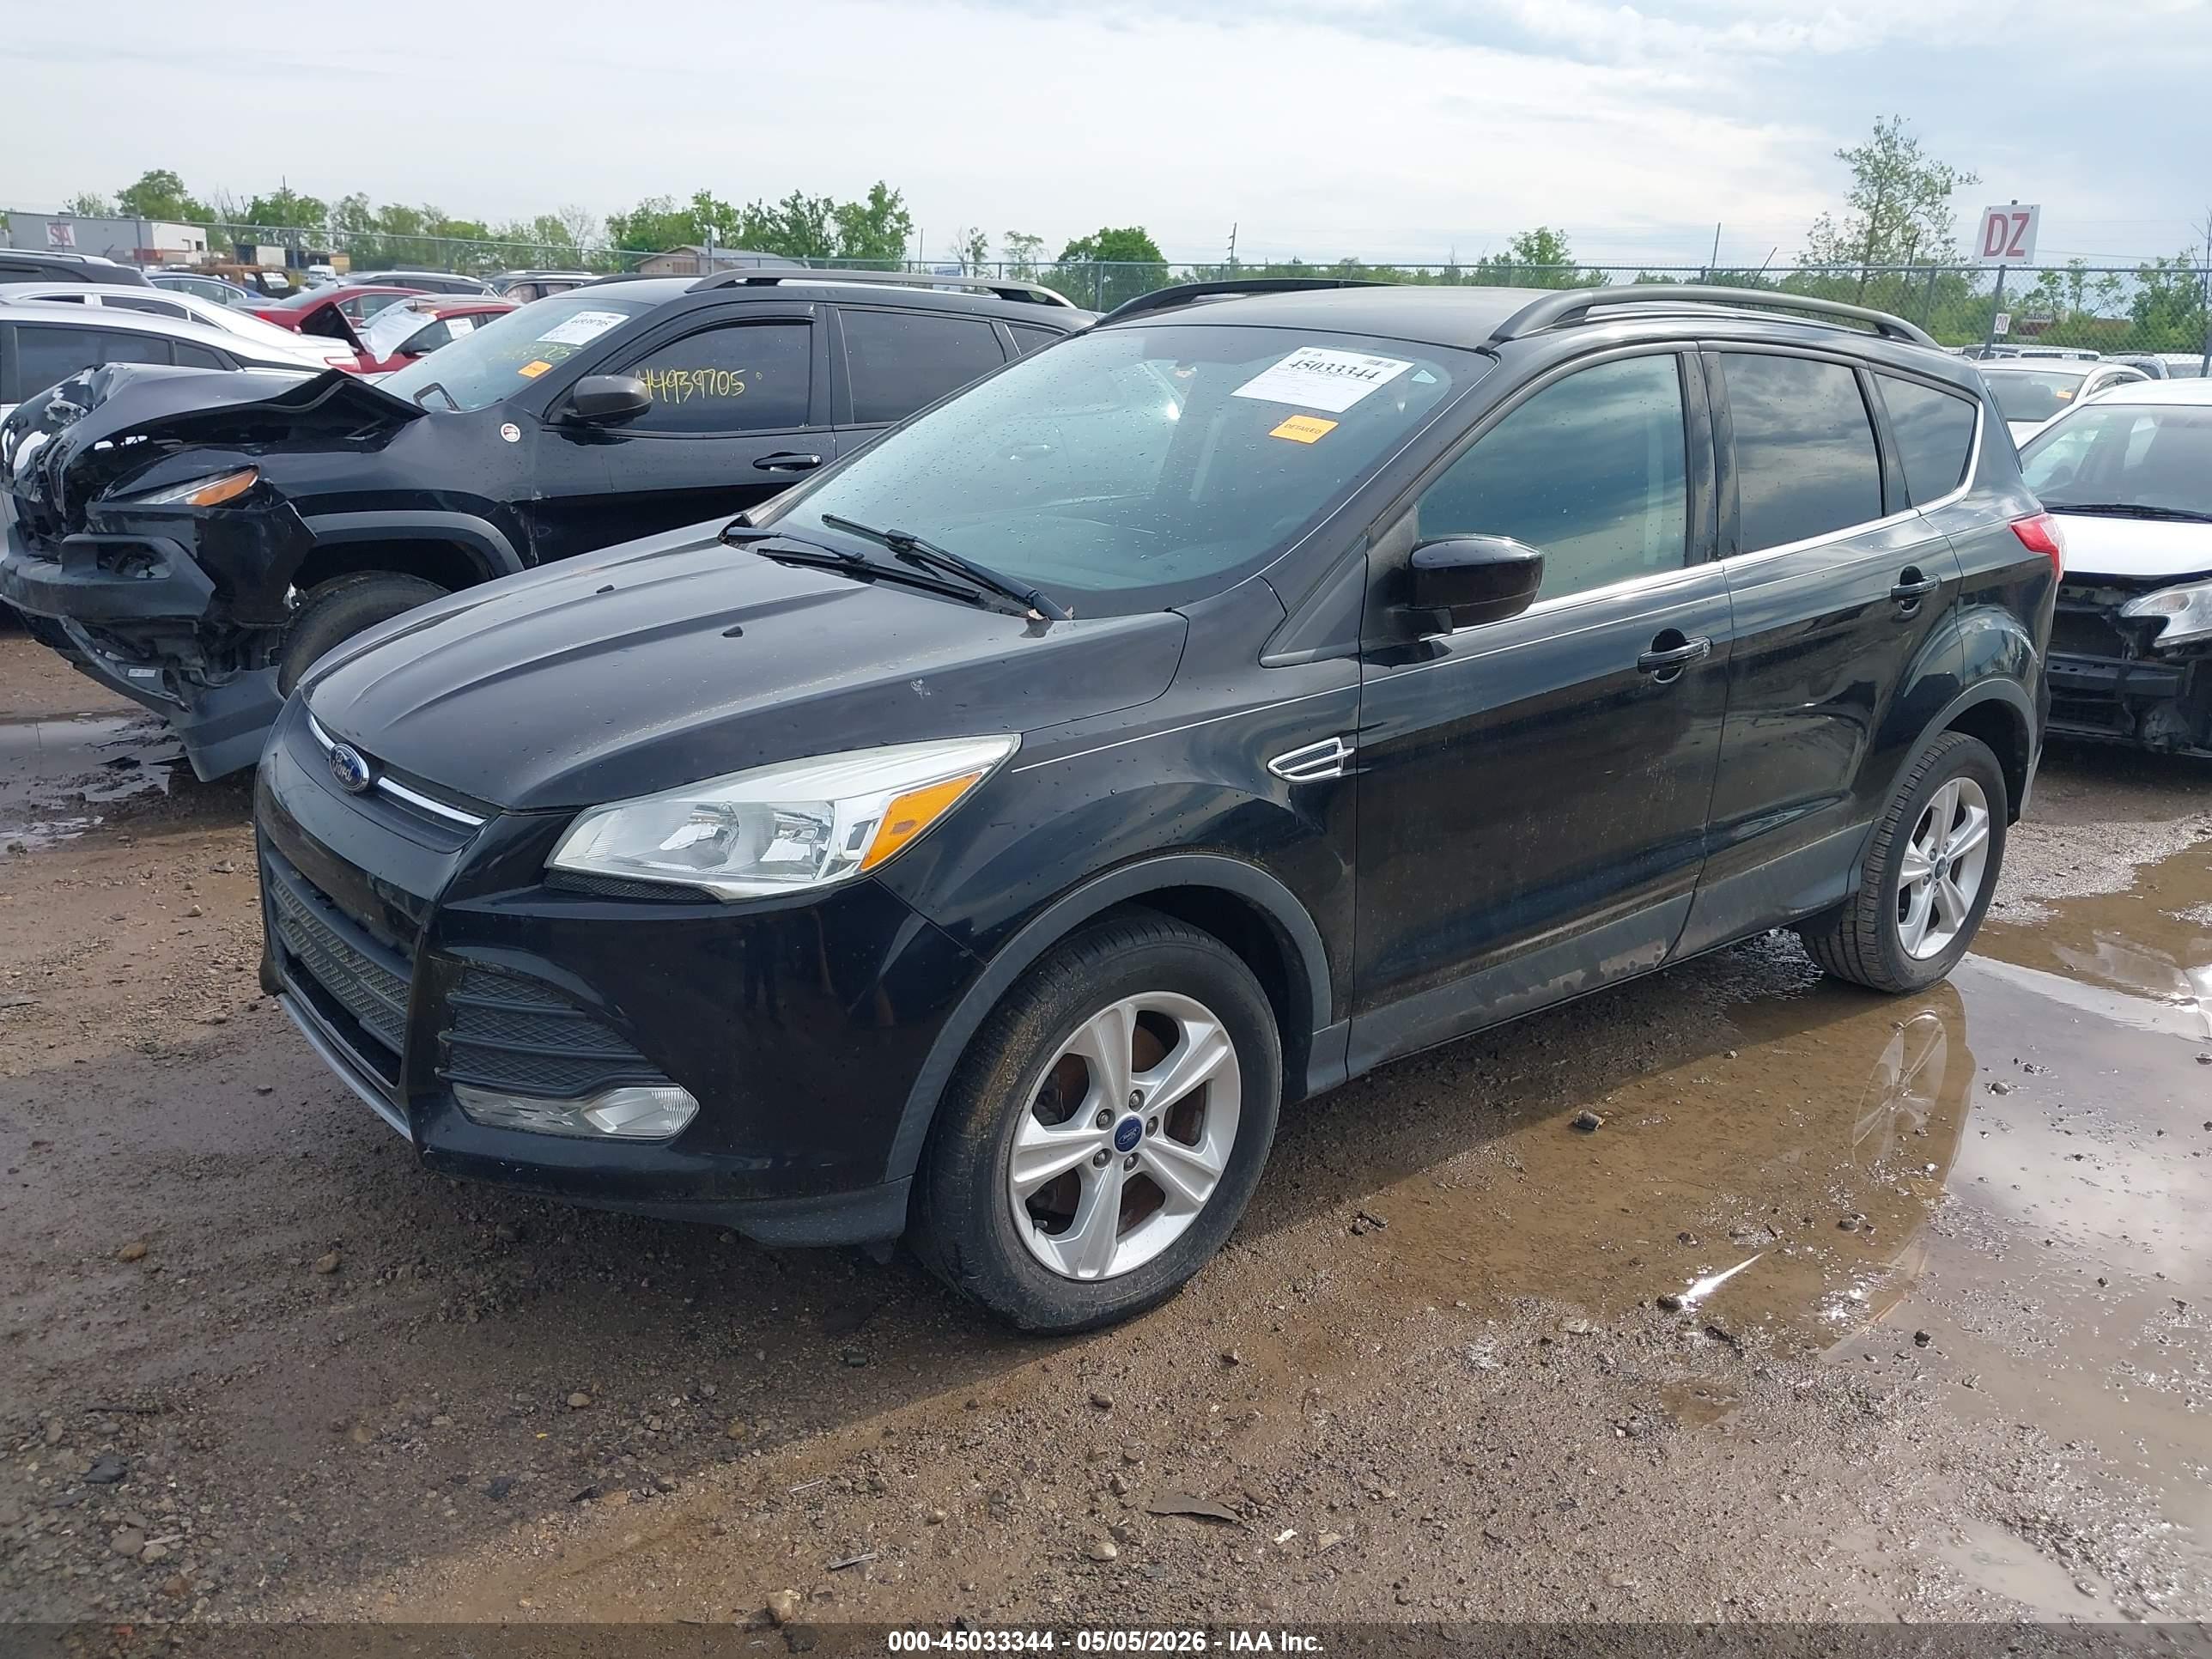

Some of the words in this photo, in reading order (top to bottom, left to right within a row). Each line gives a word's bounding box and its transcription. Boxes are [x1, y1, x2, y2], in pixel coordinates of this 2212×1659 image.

[1983, 212, 2030, 257] DZ
[1996, 315, 2008, 331] 20
[1287, 359, 1382, 380] 45033344
[635, 368, 746, 404] 44939705
[1284, 423, 1322, 434] DETAILED
[332, 750, 355, 782] Ford
